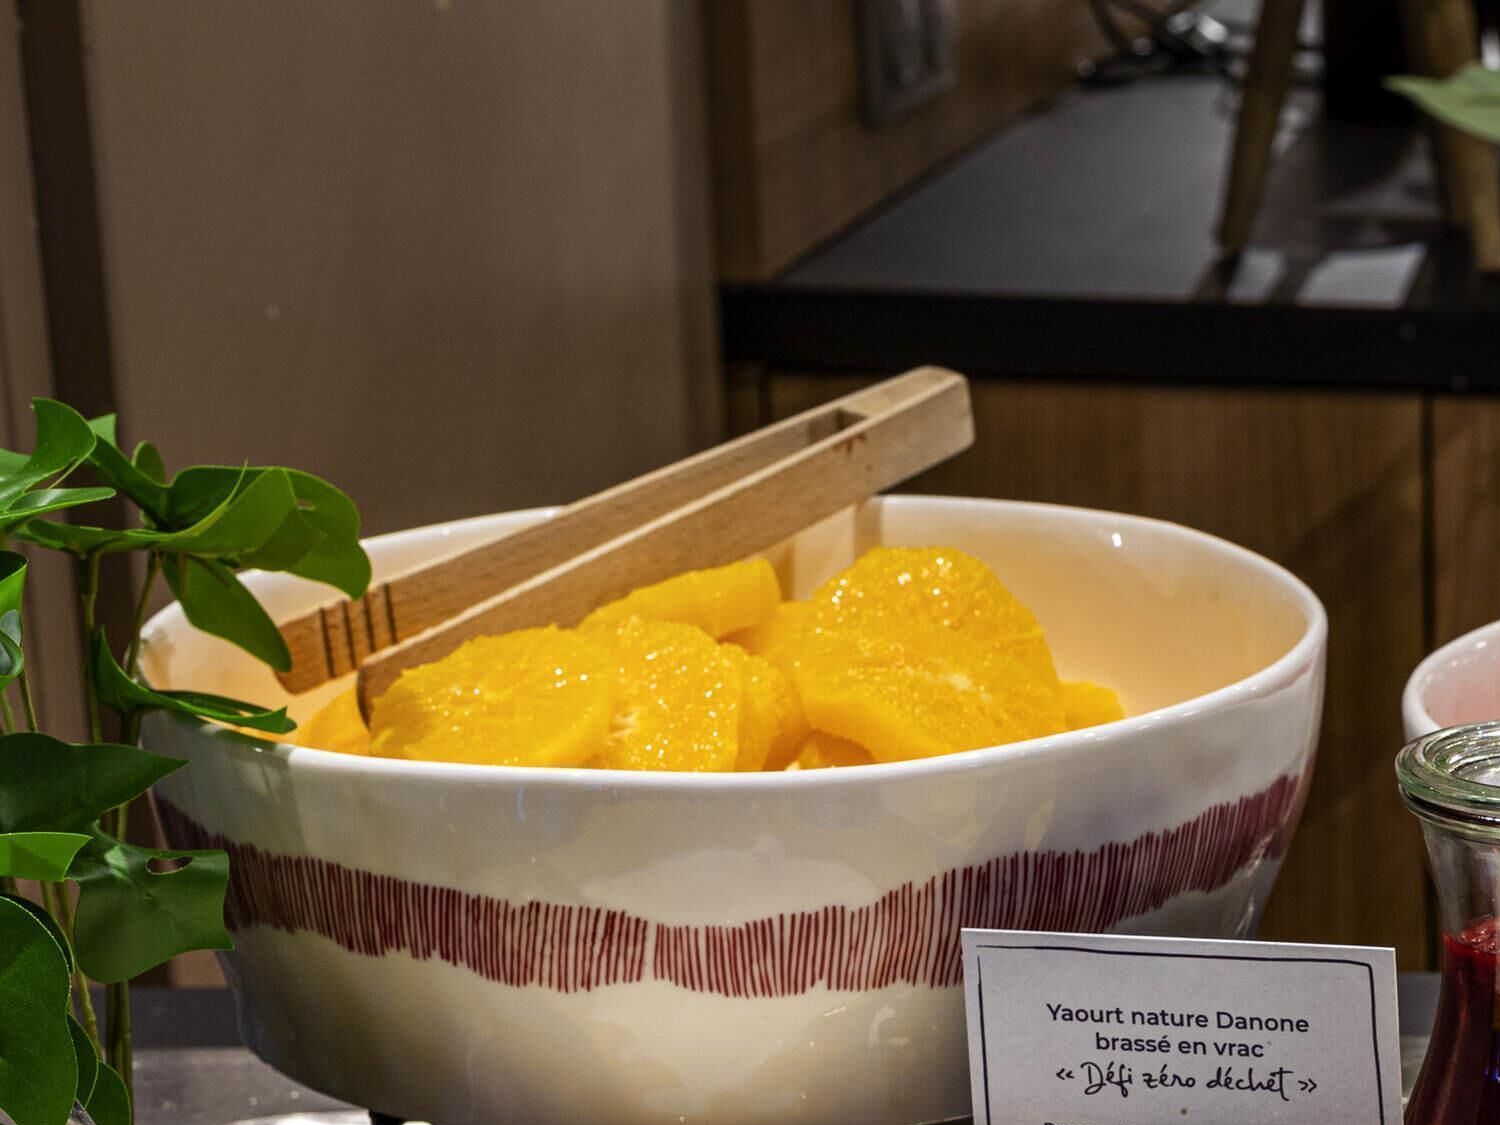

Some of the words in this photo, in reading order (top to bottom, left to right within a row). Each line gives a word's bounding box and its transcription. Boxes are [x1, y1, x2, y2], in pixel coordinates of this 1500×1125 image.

[1047, 1003, 1124, 1024] Yaourt
[1131, 1008, 1208, 1028] nature
[1216, 1011, 1309, 1032] Danone
[1095, 1032, 1171, 1053] brassé
[1178, 1041, 1207, 1055] en
[1213, 1043, 1264, 1057] vrac
